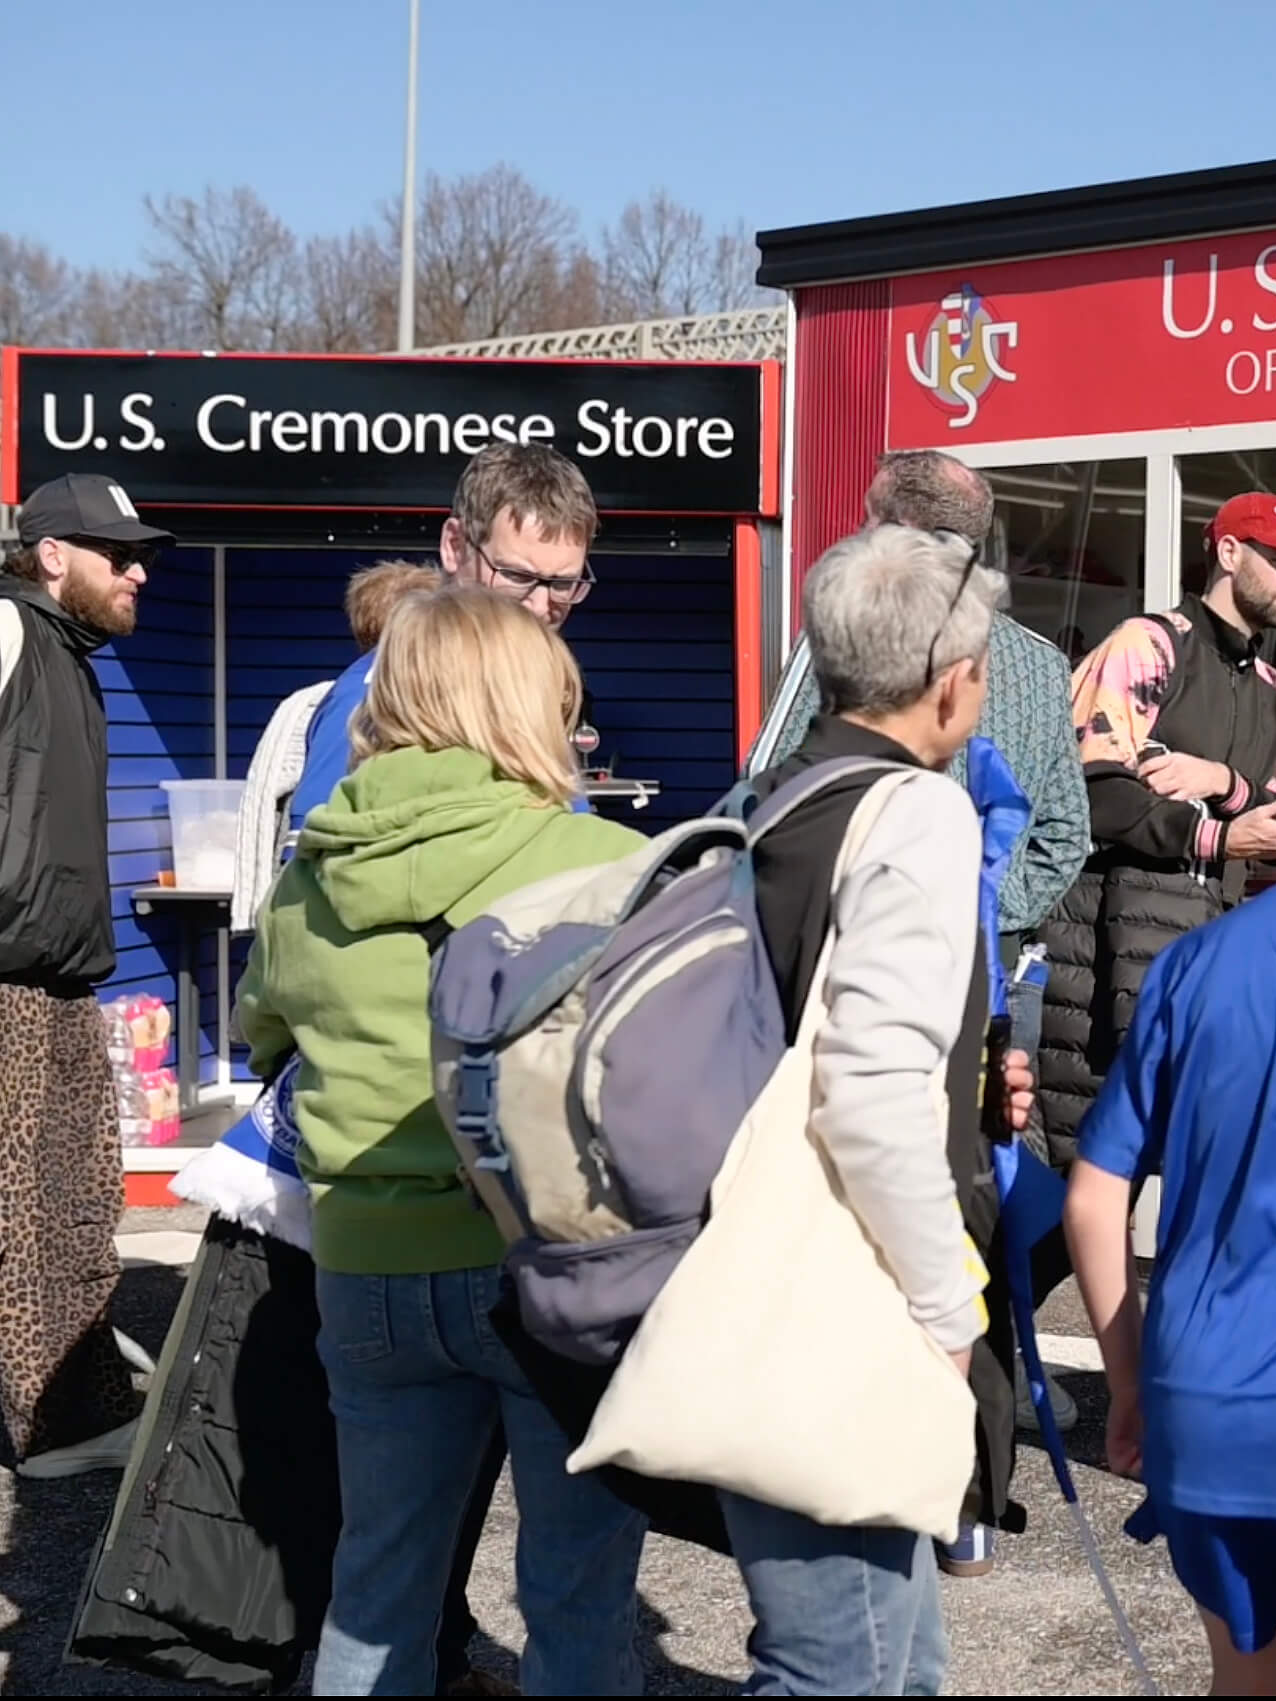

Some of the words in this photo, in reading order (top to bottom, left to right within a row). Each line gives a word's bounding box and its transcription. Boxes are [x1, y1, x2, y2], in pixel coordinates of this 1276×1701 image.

[42, 392, 167, 452] U.S.
[195, 393, 556, 456] Cremonese
[575, 398, 735, 459] Store
